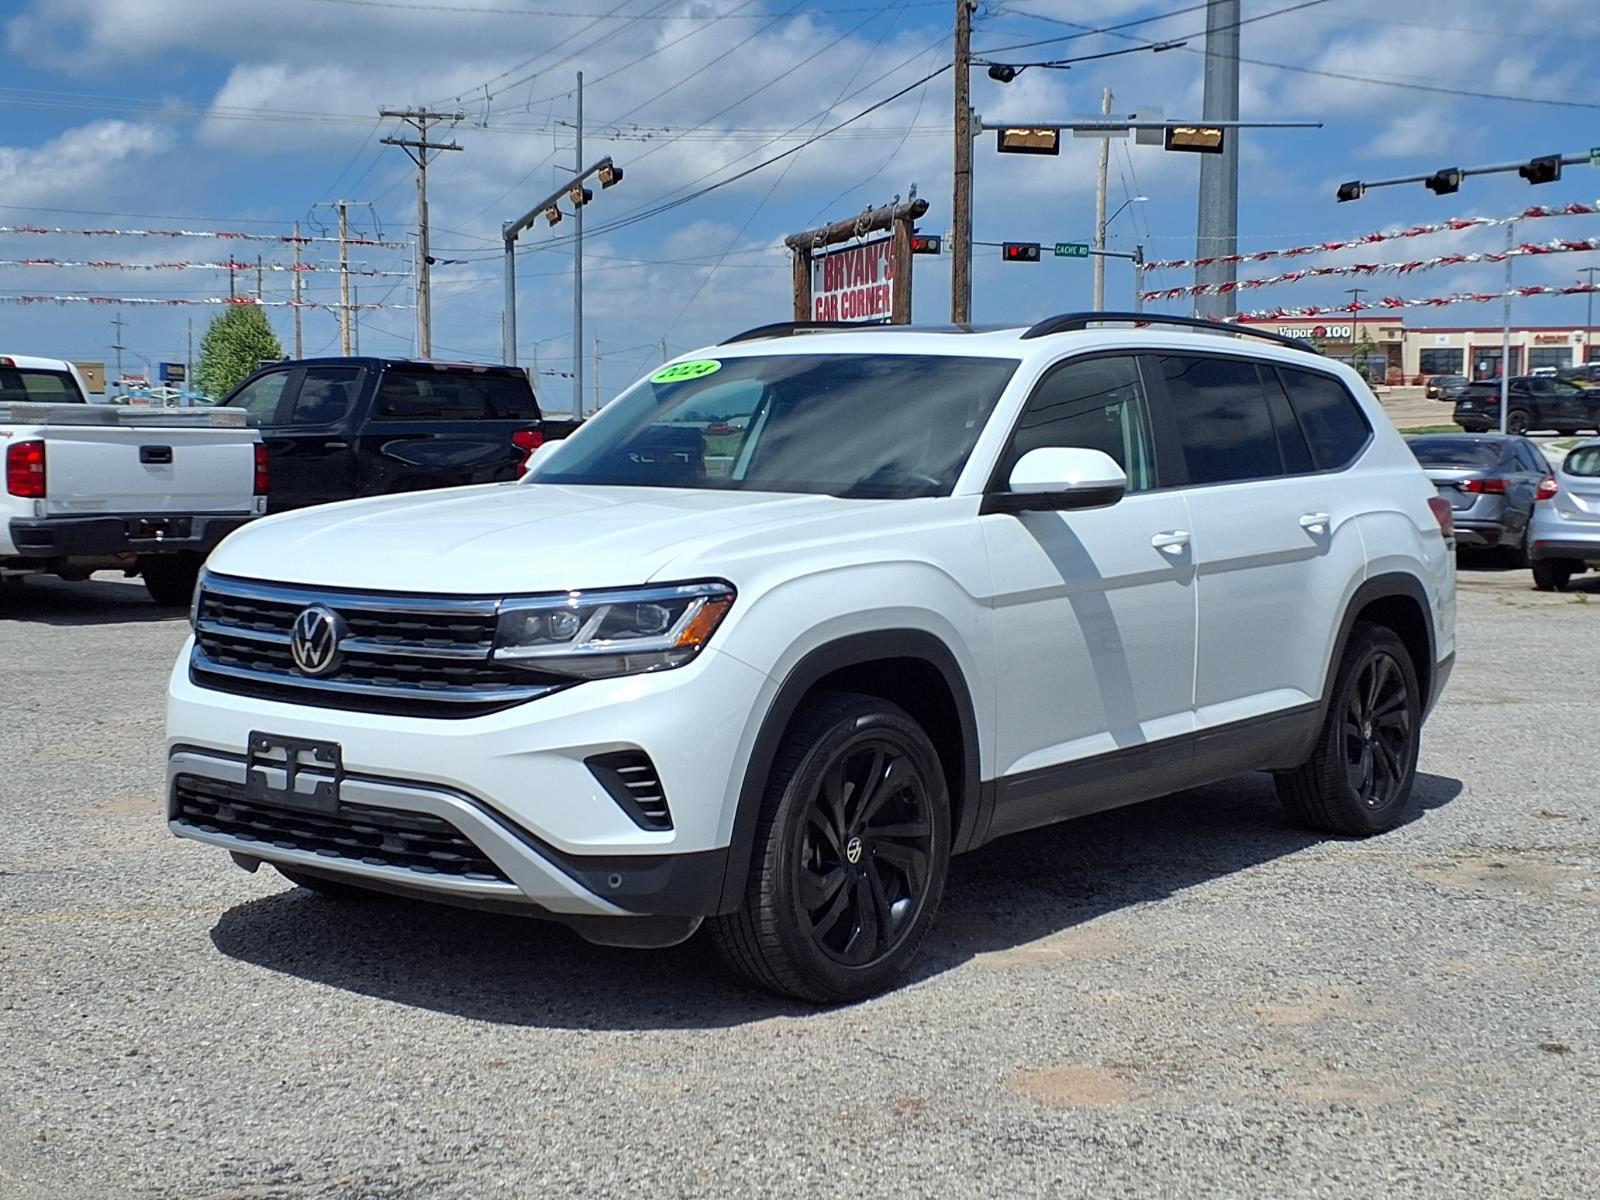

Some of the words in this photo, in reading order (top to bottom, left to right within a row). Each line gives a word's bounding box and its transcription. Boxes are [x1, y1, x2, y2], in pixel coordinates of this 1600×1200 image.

[1056, 244, 1078, 255] CACHE
[1079, 246, 1088, 255] RD
[823, 240, 896, 293] BRYAN'S
[815, 294, 838, 322] CAR
[841, 284, 891, 320] CORNER
[1279, 326, 1313, 339] Vapor
[1325, 326, 1351, 338] 100
